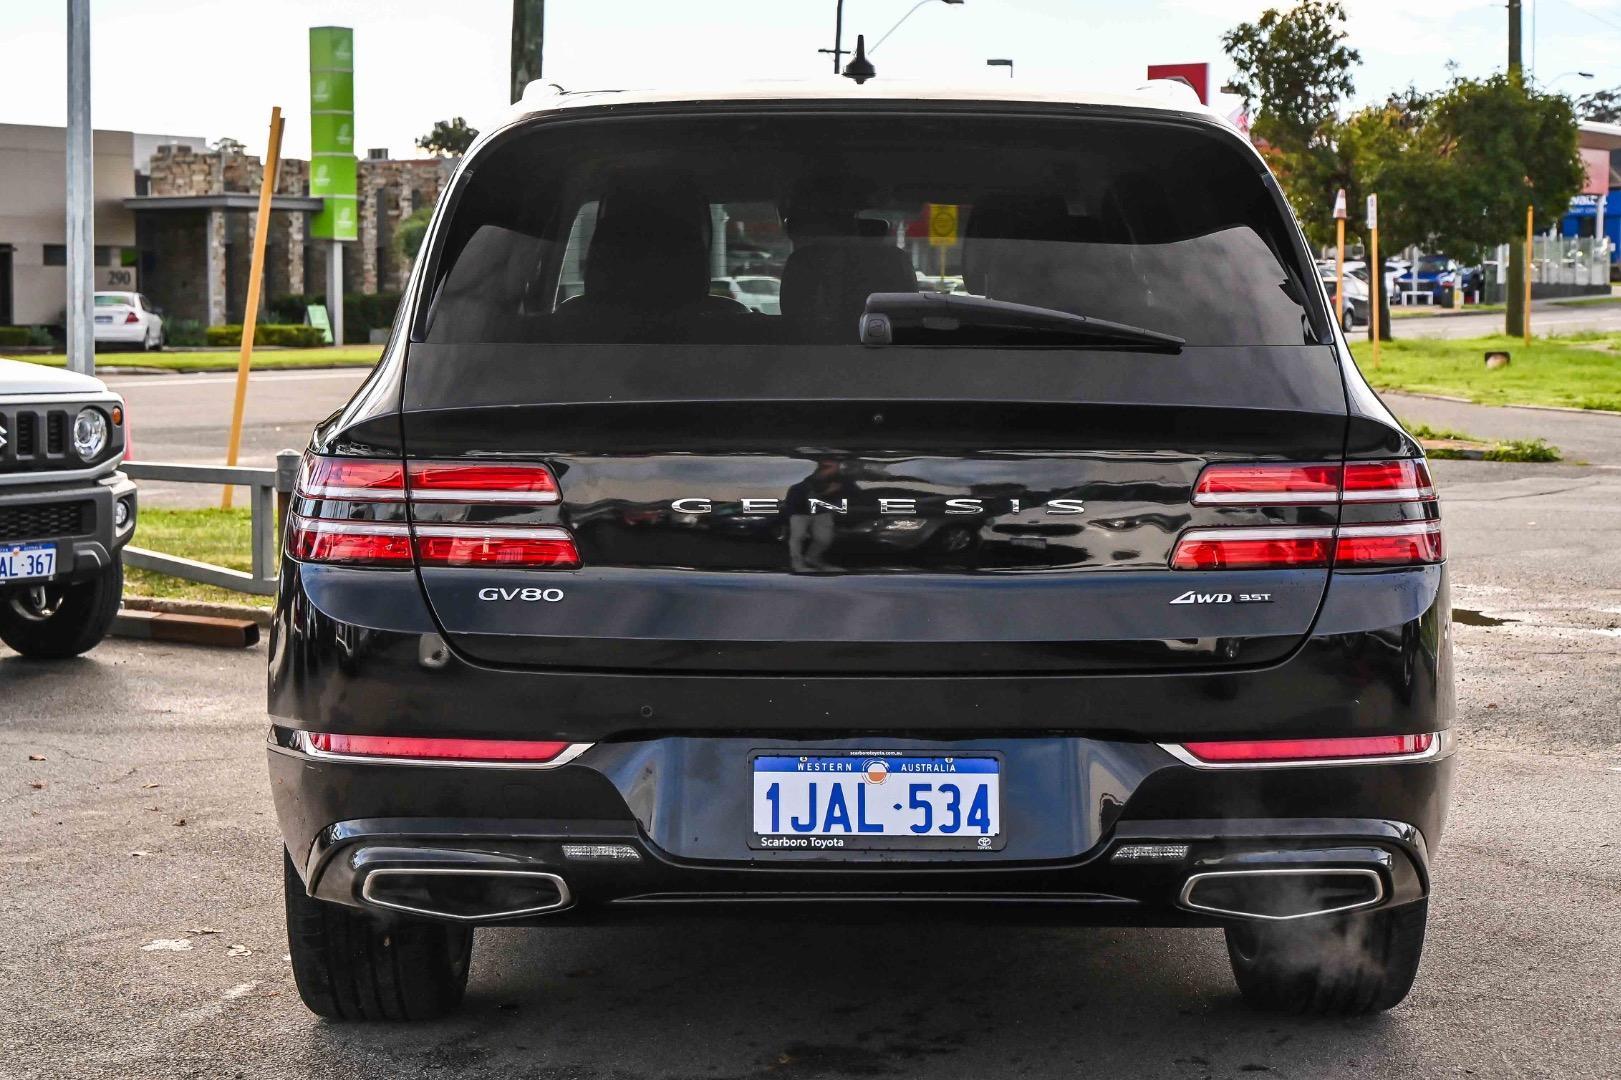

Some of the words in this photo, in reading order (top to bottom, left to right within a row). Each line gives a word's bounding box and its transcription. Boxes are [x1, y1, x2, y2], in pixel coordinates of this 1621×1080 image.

[108, 270, 131, 286] 290
[671, 498, 1085, 514] GENESIS
[478, 587, 564, 602] GV80
[797, 762, 852, 772] WESTERN
[901, 763, 956, 773] AUSTRALIA
[761, 837, 808, 847] Scarboro
[809, 837, 844, 849] Toyota
